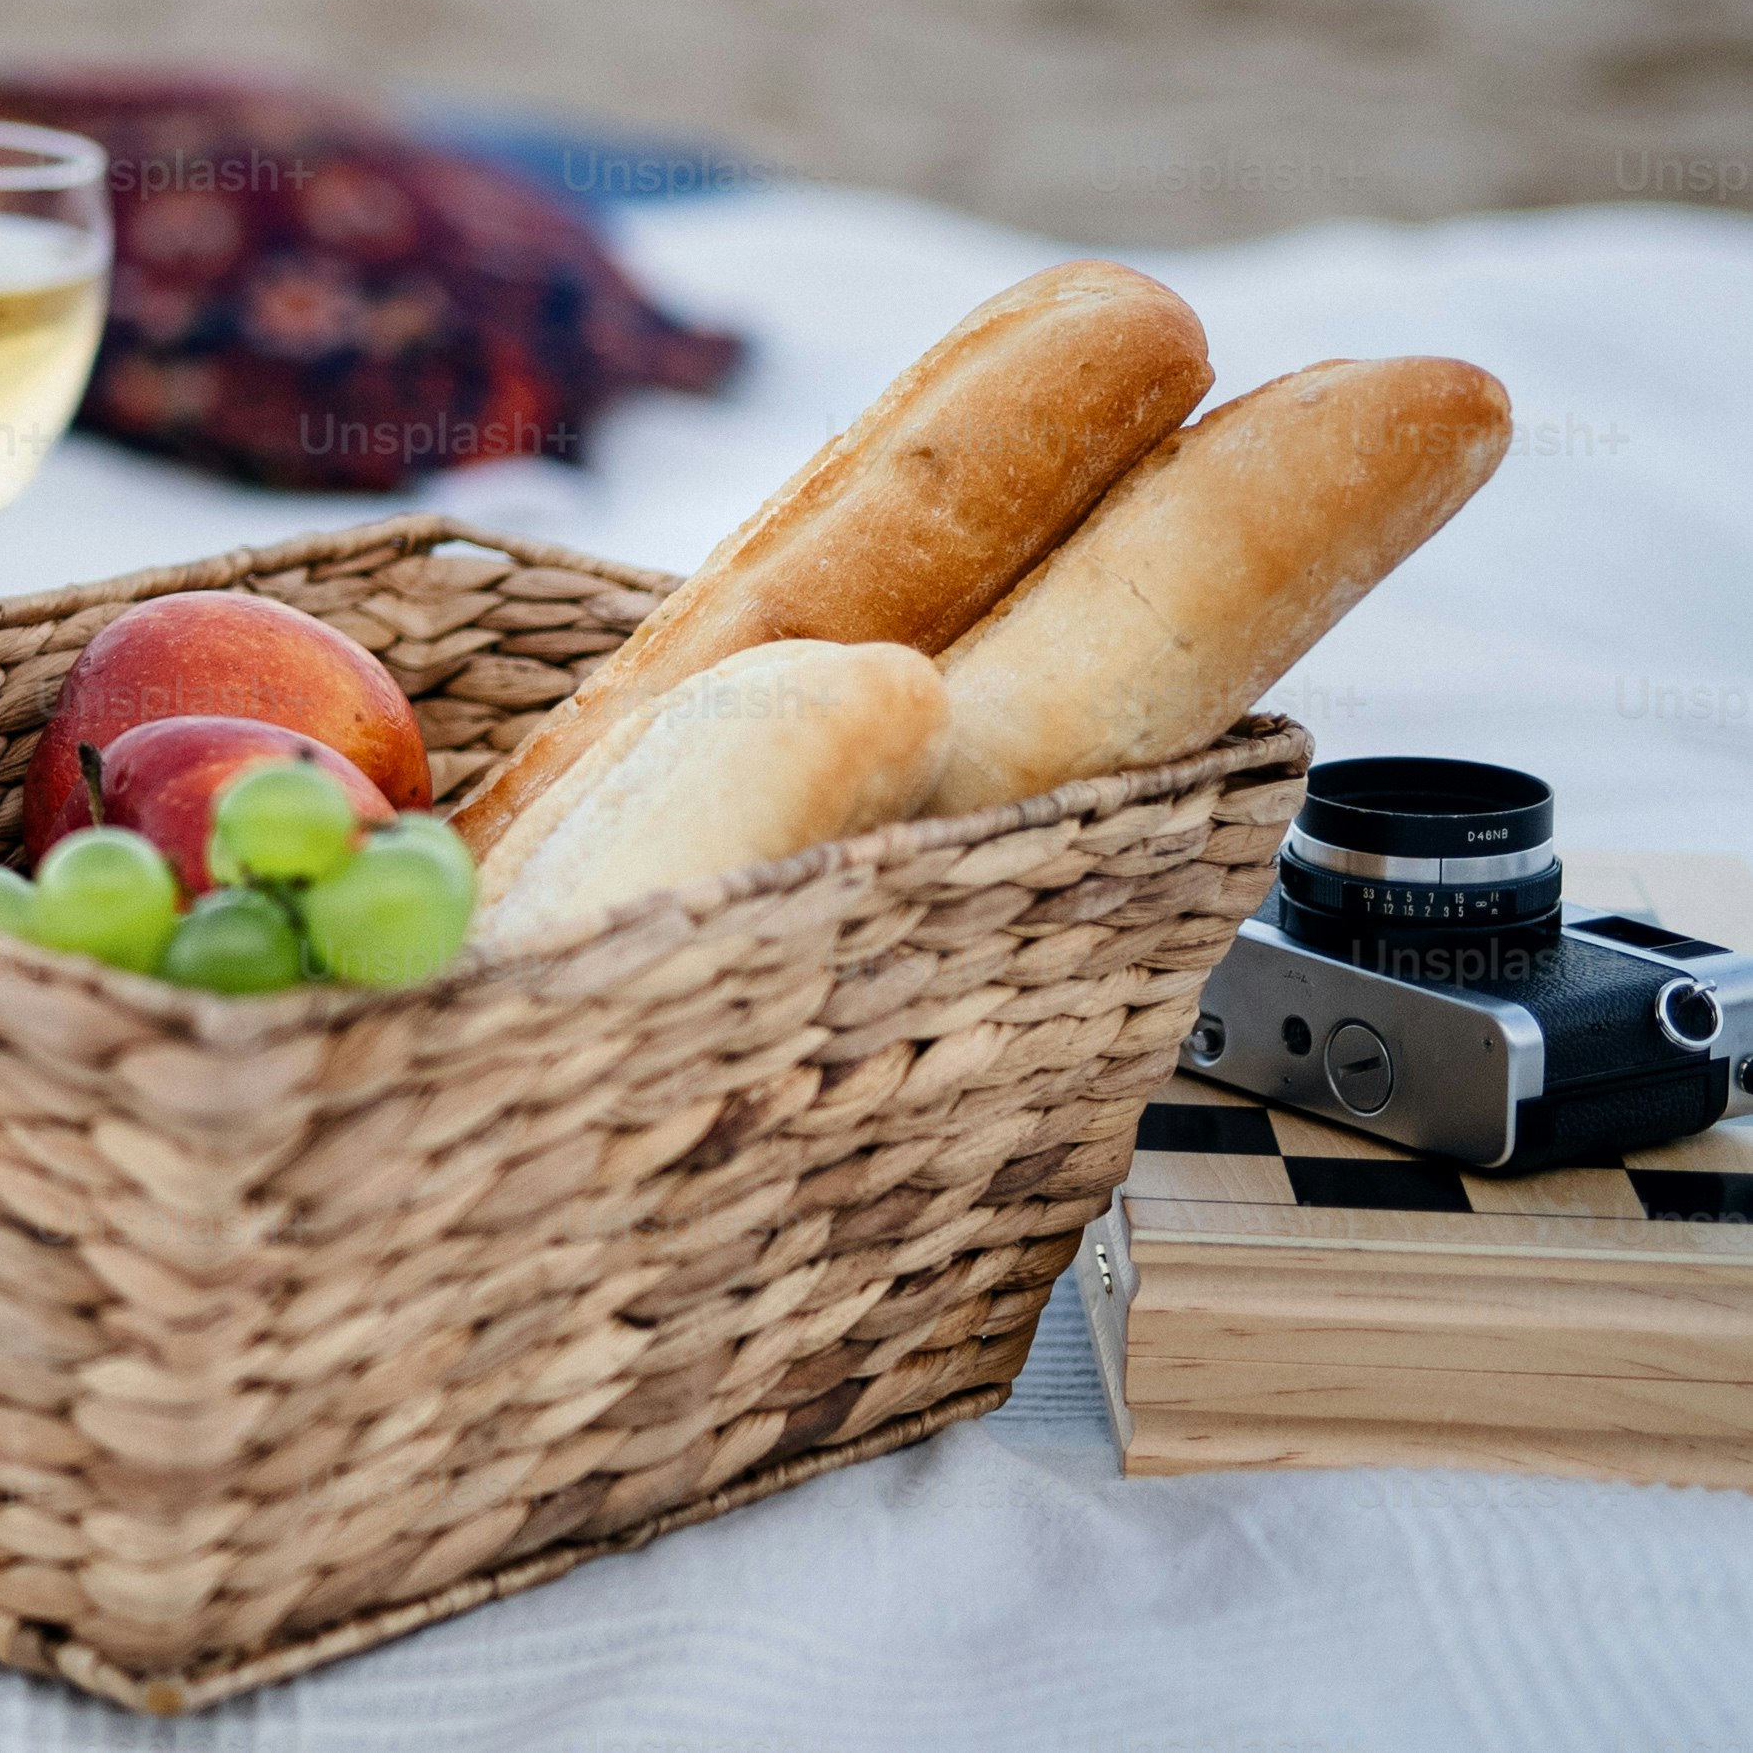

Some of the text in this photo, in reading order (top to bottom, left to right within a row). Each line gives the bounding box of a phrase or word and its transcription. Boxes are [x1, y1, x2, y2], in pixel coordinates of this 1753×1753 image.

[1406, 891, 1413, 903] 5
[1454, 892, 1464, 904] 15
[1424, 905, 1431, 917] 2
[1443, 906, 1450, 918] 3
[1458, 905, 1464, 917] 5
